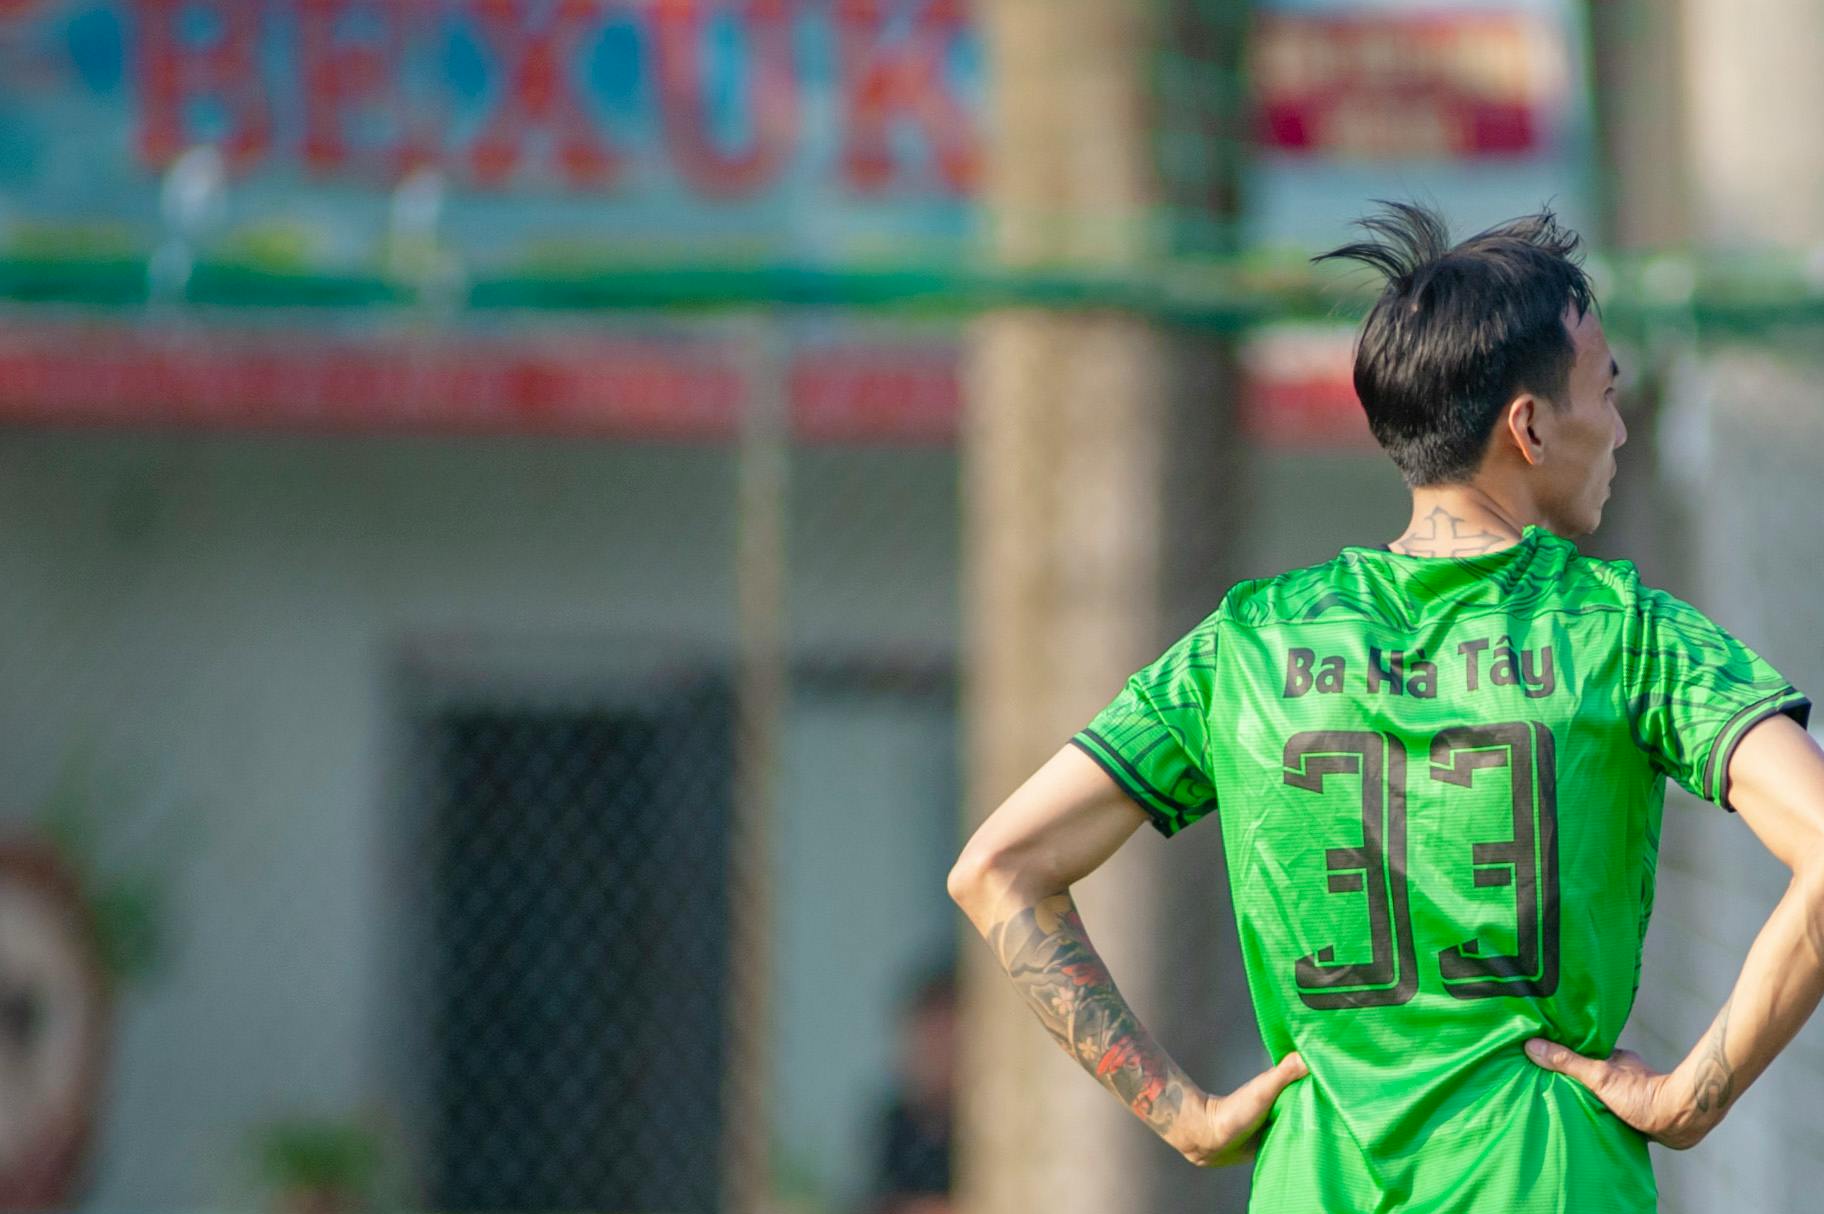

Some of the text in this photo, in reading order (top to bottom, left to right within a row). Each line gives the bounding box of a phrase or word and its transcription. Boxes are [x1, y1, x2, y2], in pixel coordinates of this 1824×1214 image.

[1283, 634, 1556, 699] Ba Hà Tây
[1283, 720, 1560, 1011] 33
